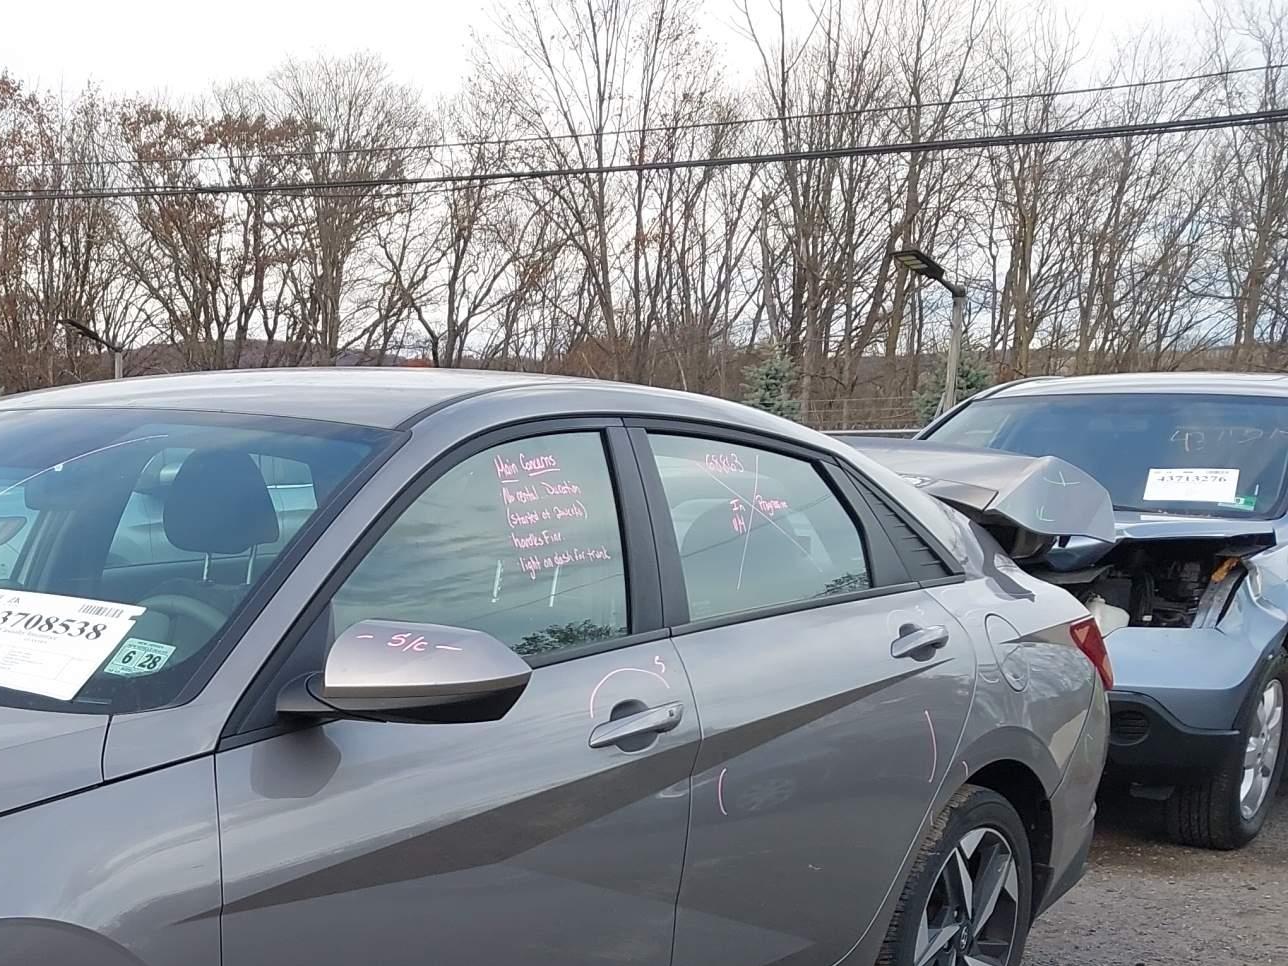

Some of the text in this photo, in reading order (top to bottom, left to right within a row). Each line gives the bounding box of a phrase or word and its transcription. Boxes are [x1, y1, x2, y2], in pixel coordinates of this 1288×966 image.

[494, 453, 557, 478] Main Concerns
[519, 557, 541, 581] light
[121, 650, 136, 664] 6
[138, 653, 162, 670] 28
